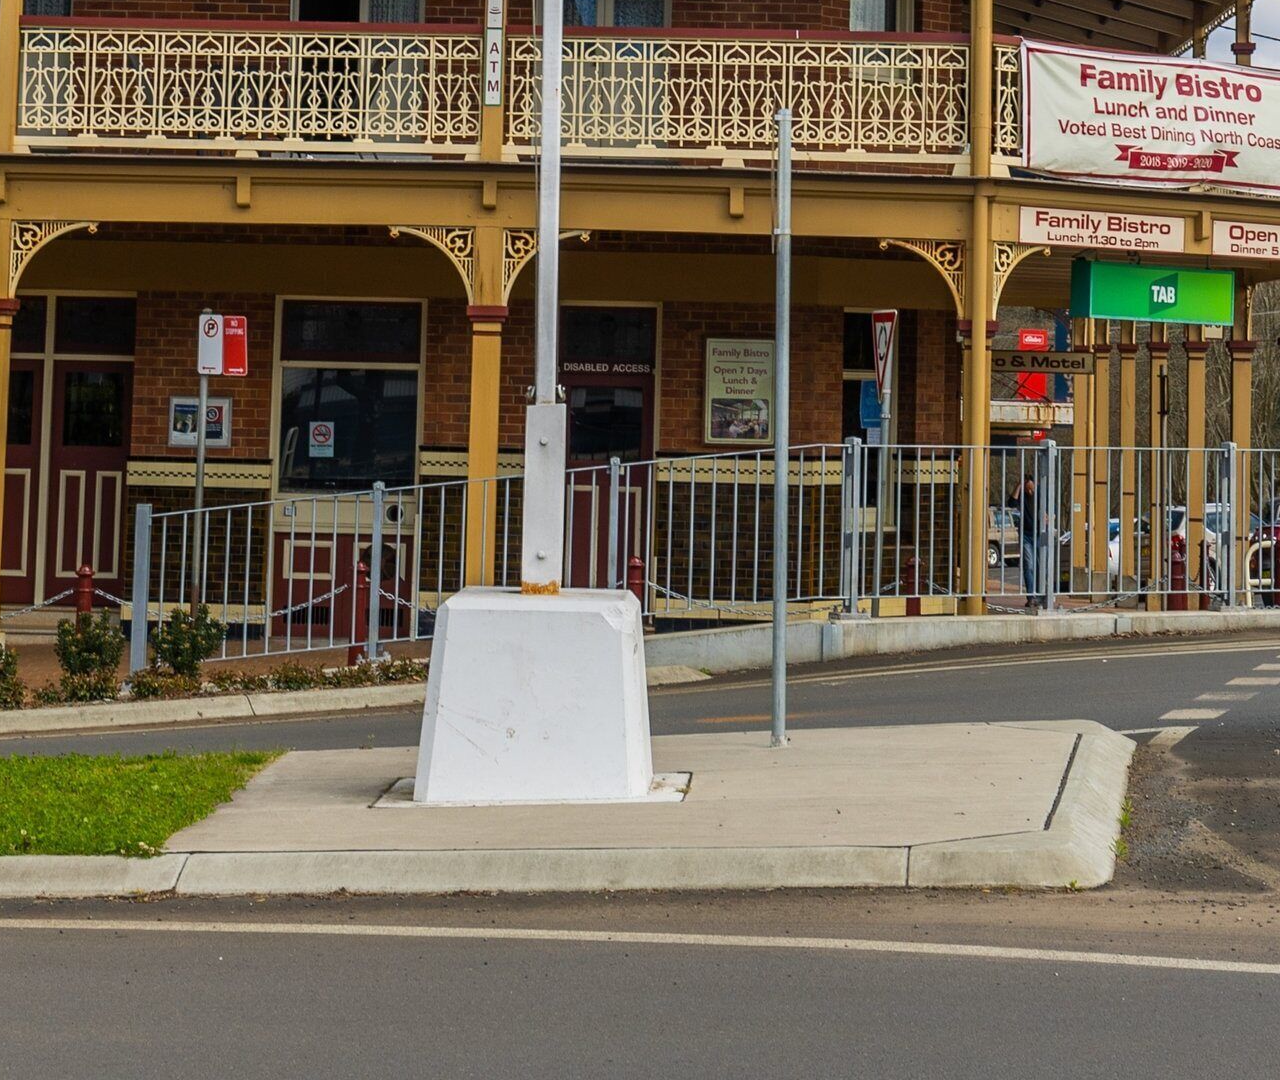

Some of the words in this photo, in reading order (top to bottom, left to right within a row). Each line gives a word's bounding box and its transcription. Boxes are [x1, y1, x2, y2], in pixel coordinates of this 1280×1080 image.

[487, 42, 500, 93] ATM
[1080, 63, 1168, 100] Family
[1175, 73, 1263, 103] Bistro
[1093, 97, 1150, 118] Lunch
[1156, 105, 1187, 121] and
[1193, 106, 1256, 126] Dinner
[1058, 119, 1107, 136] Voted
[1112, 123, 1147, 140] Best
[1151, 126, 1196, 146] Dining
[1200, 129, 1243, 146] North
[1035, 211, 1102, 233] Family
[1107, 216, 1171, 235] Bistro
[1047, 231, 1084, 243] Lunch
[1088, 235, 1117, 246] 11.30
[1120, 237, 1132, 247] to
[1134, 237, 1159, 249] 2pm
[1229, 225, 1278, 244] Open
[1230, 243, 1267, 255] Dinner
[1151, 285, 1176, 303] TAB
[712, 347, 741, 359] Family
[743, 348, 770, 358] Bistro
[1010, 355, 1026, 368] &
[1031, 356, 1086, 369] Motel
[563, 362, 609, 372] DISABLED
[612, 364, 651, 374] ACCESS
[713, 365, 738, 376] Open
[739, 366, 745, 374] 7
[746, 366, 768, 376] Days
[722, 377, 749, 385] Lunch
[750, 377, 758, 385] &
[725, 386, 755, 395] Dinner
